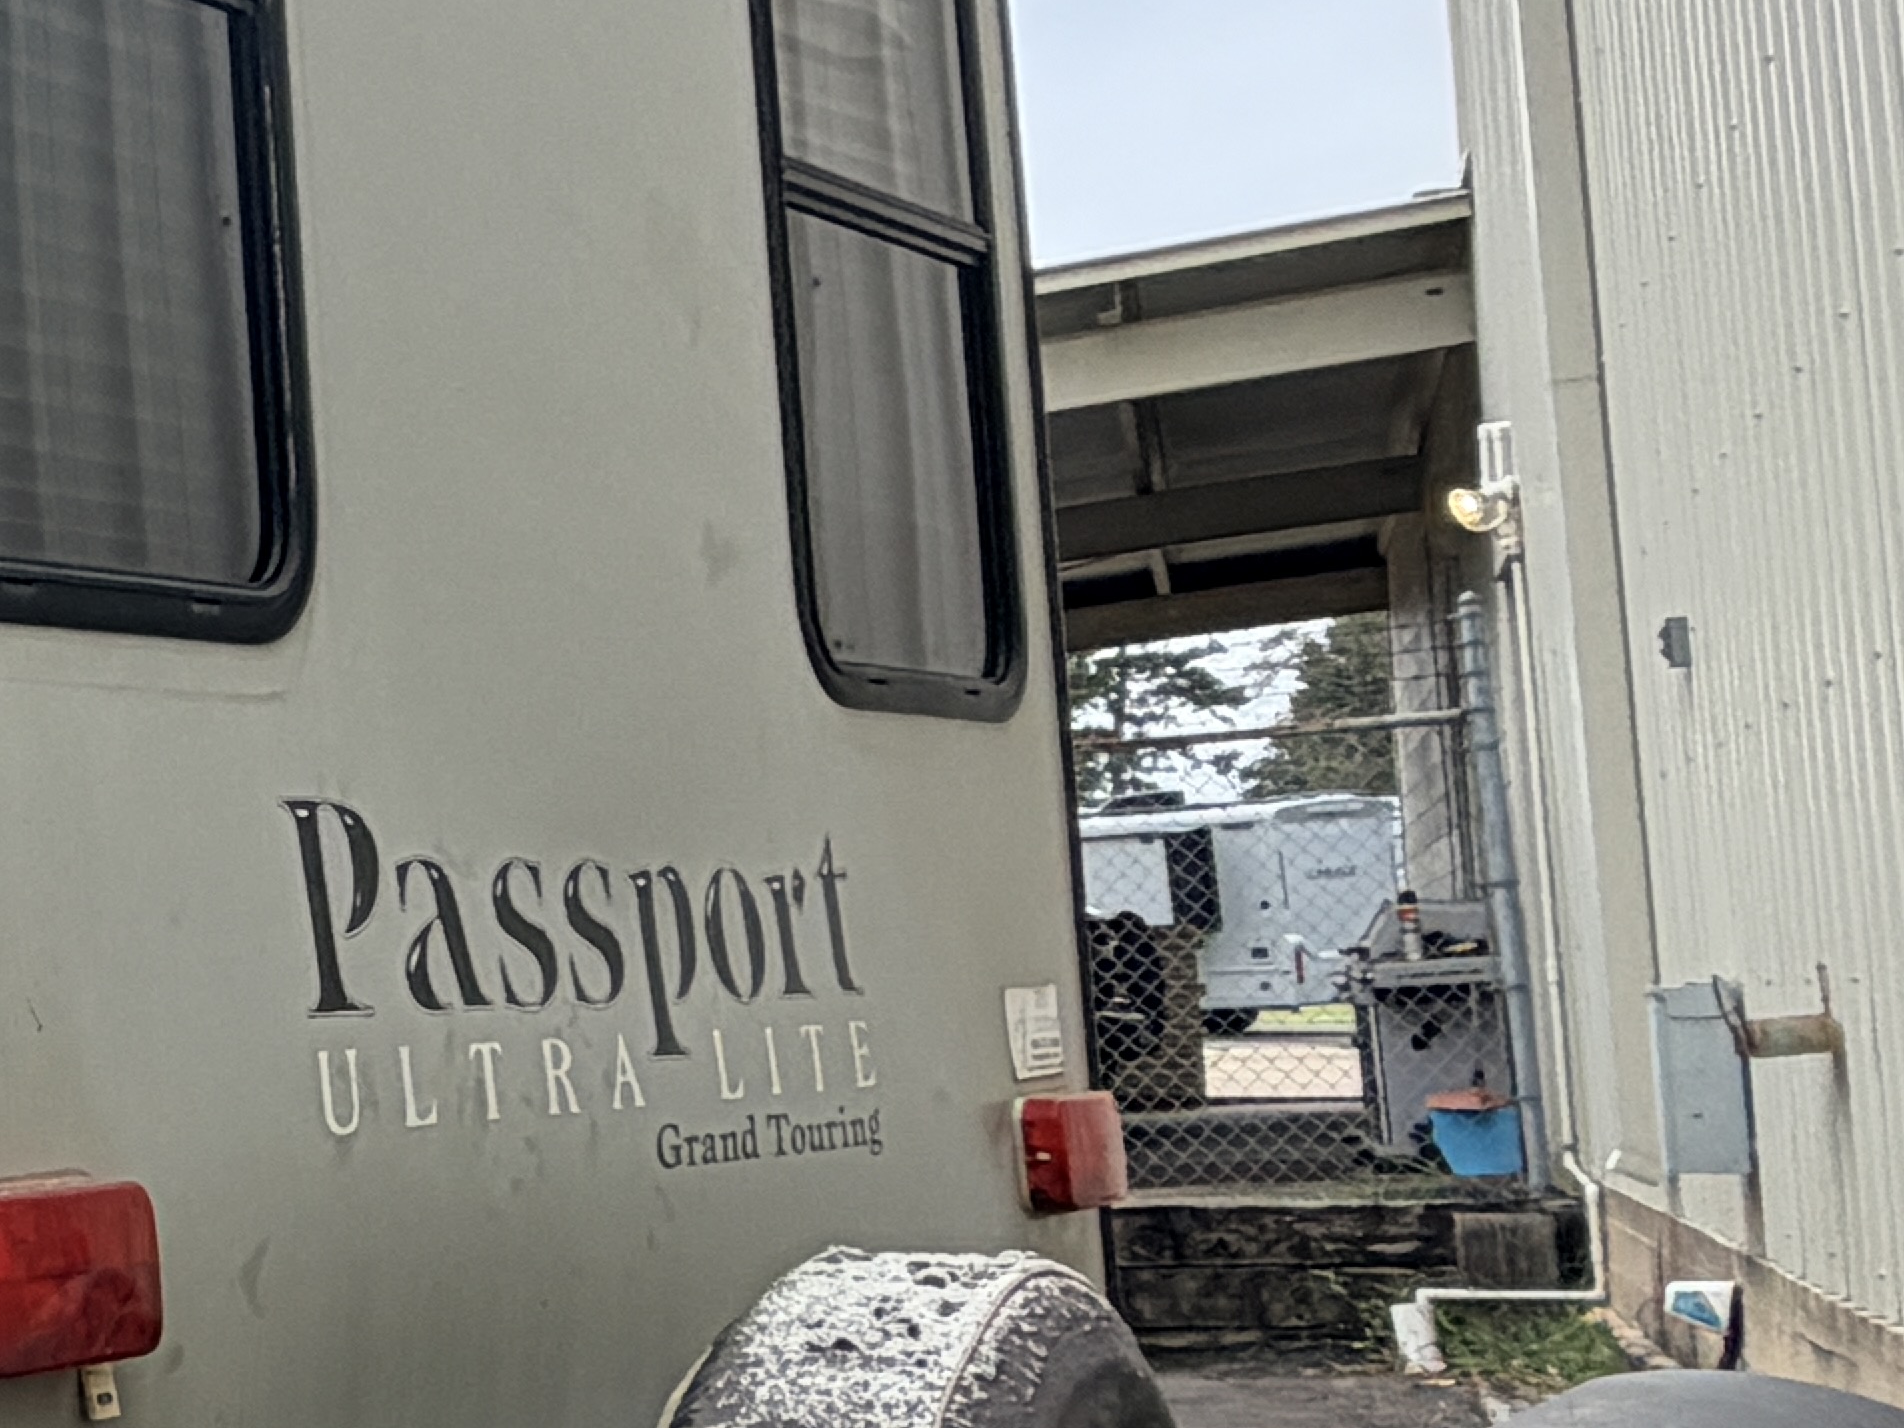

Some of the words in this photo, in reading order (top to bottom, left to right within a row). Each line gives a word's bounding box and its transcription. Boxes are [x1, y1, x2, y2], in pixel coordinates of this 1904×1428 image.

[278, 795, 865, 1059] Passport
[317, 1034, 646, 1136] ULTRA
[712, 1020, 879, 1101] LITE
[656, 1114, 759, 1170] Grand
[767, 1106, 884, 1158] Touring
